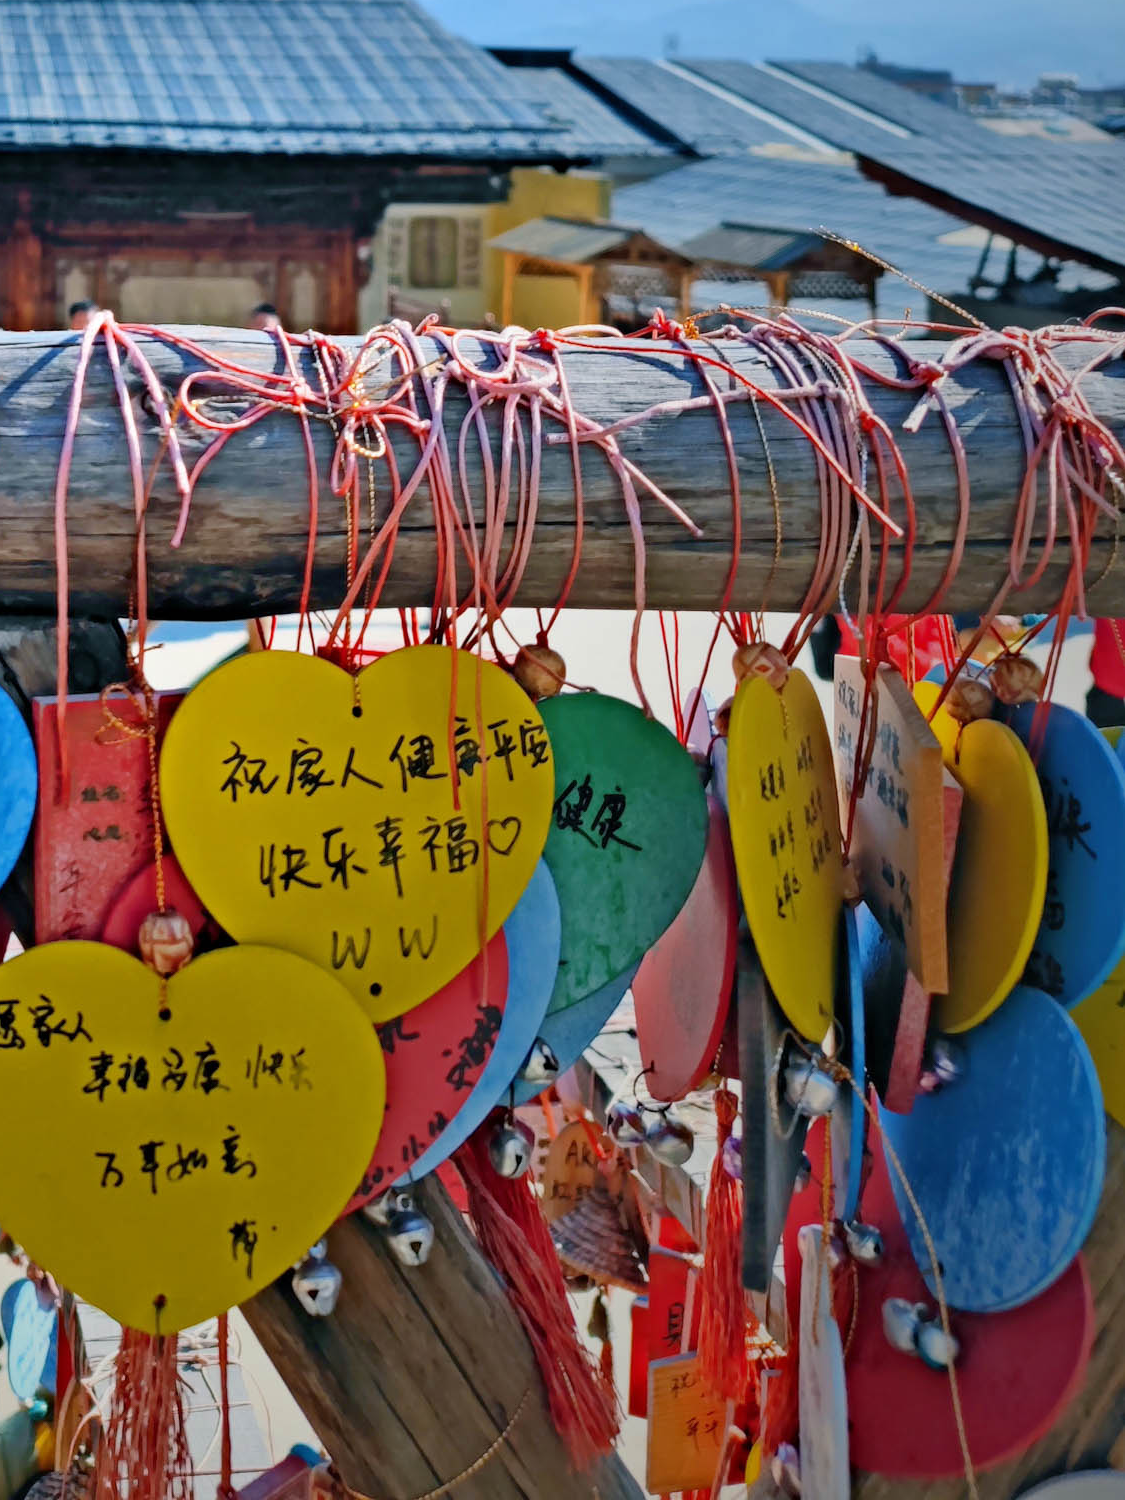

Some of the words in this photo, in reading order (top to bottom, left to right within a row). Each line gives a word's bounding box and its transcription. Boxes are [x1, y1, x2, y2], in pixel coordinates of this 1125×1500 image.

[553, 773, 644, 852] 健康
[259, 814, 480, 899] 快乐幸福
